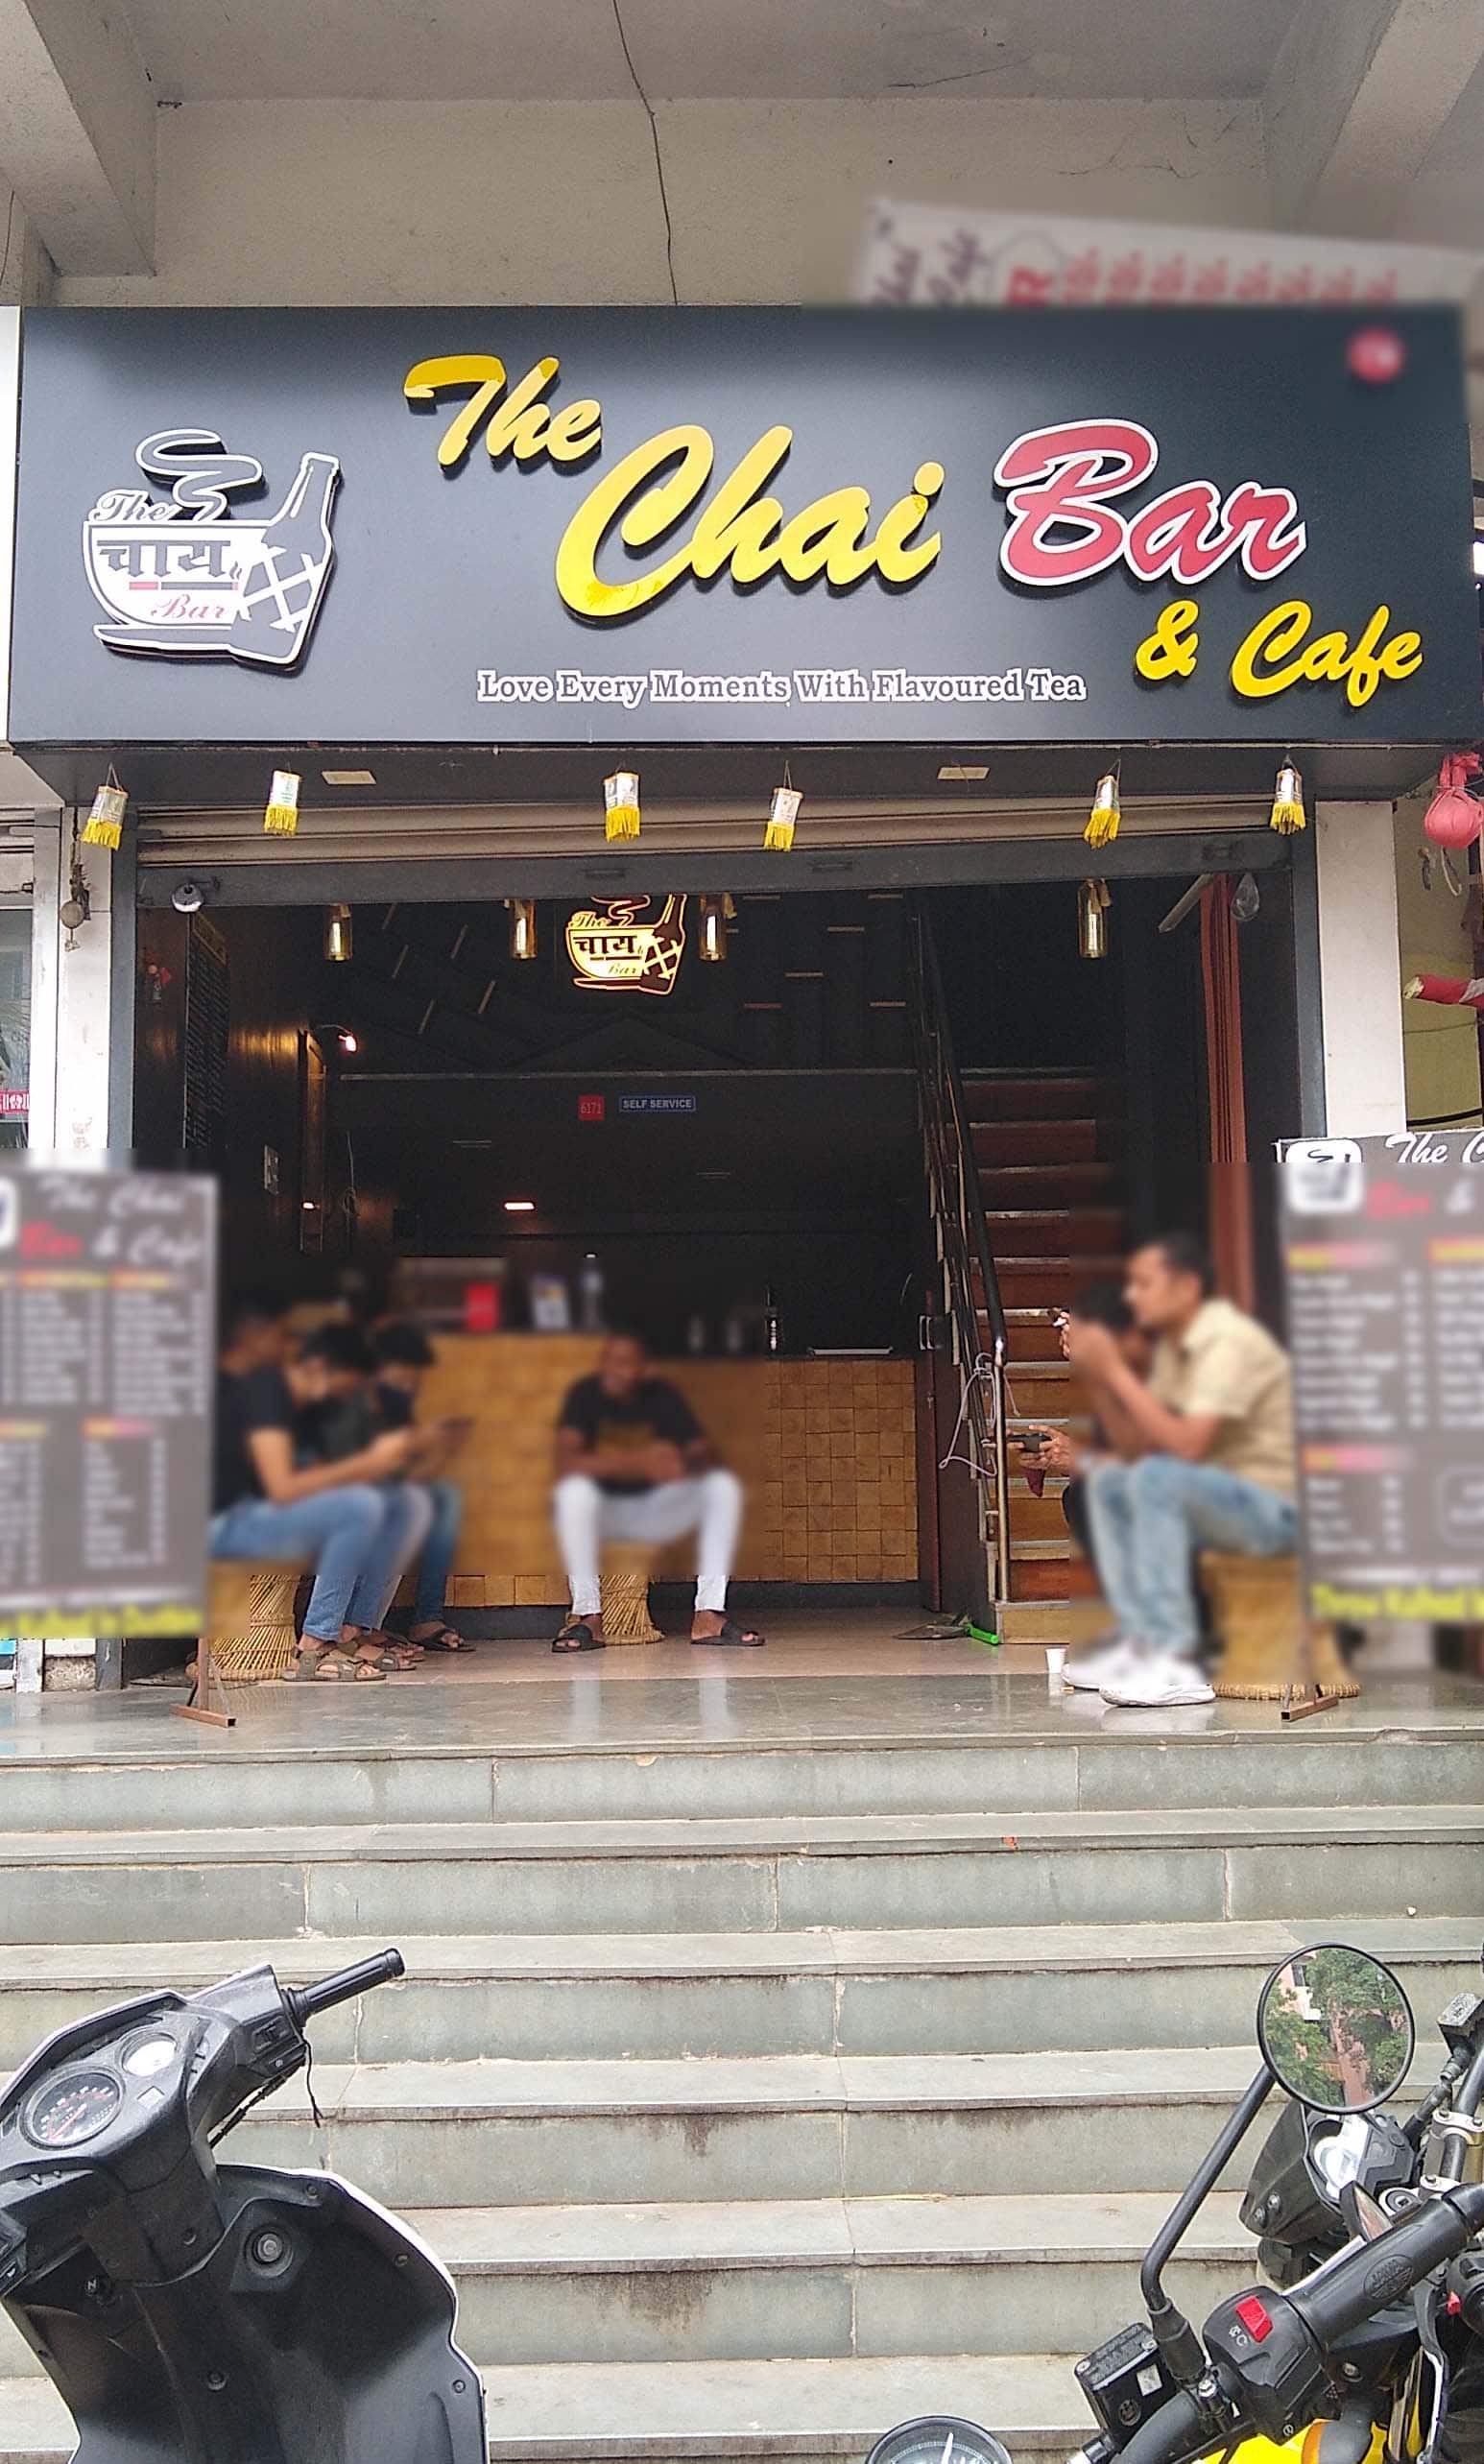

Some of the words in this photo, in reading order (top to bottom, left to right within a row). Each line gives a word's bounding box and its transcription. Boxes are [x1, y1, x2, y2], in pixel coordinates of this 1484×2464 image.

[404, 353, 602, 466] The
[91, 490, 173, 521] The
[556, 423, 946, 617] Chai
[993, 419, 1307, 586] Bar
[97, 540, 231, 577] चाय
[151, 594, 226, 619] Bar
[1136, 600, 1199, 682] &
[1232, 600, 1424, 707] Cafe
[480, 673, 551, 701] Love
[559, 673, 645, 706] Every
[653, 672, 790, 701] Moments
[796, 672, 868, 701] With
[874, 671, 1021, 700] Flavoured
[1028, 671, 1085, 699] Tea
[573, 936, 637, 955] चाय
[622, 1099, 648, 1110] SELF
[651, 1098, 692, 1109] SERVICE
